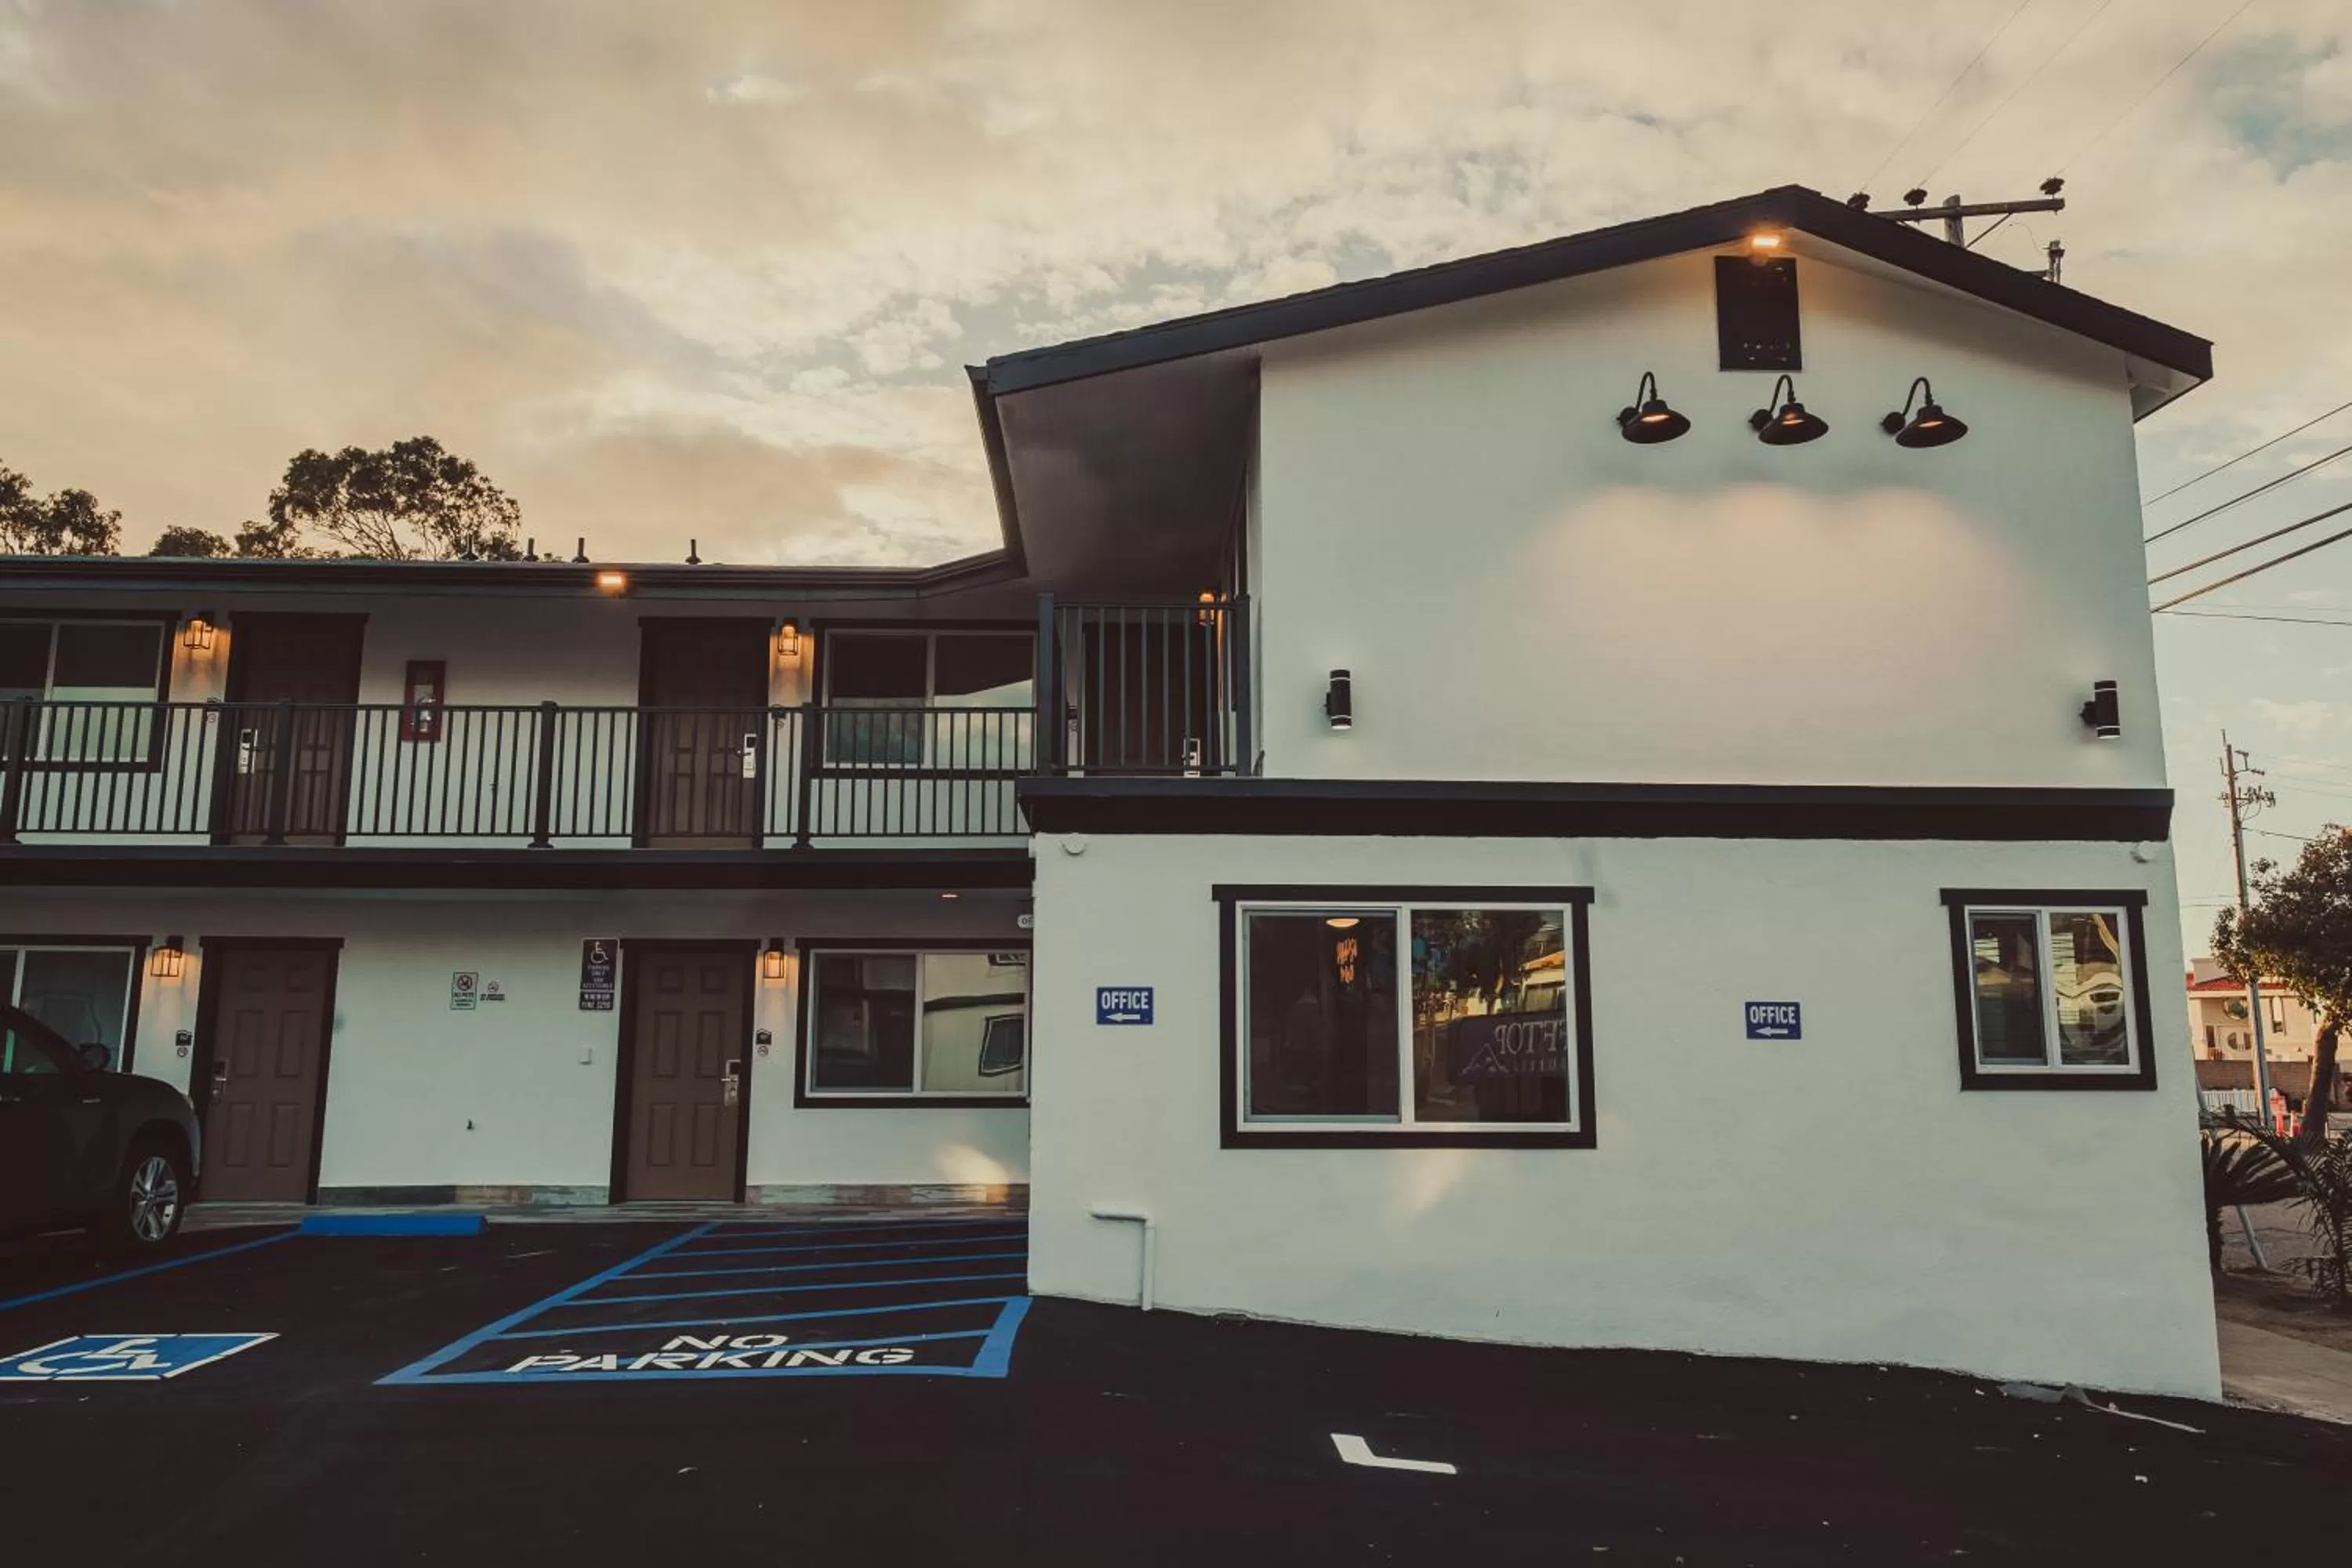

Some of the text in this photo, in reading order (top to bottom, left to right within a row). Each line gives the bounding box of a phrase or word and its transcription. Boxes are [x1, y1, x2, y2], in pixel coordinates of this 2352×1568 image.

[1102, 991, 1149, 1009] OFFICE
[1750, 1006, 1796, 1024] OFFICE
[659, 1335, 788, 1351] NO
[506, 1348, 915, 1373] PARKING
